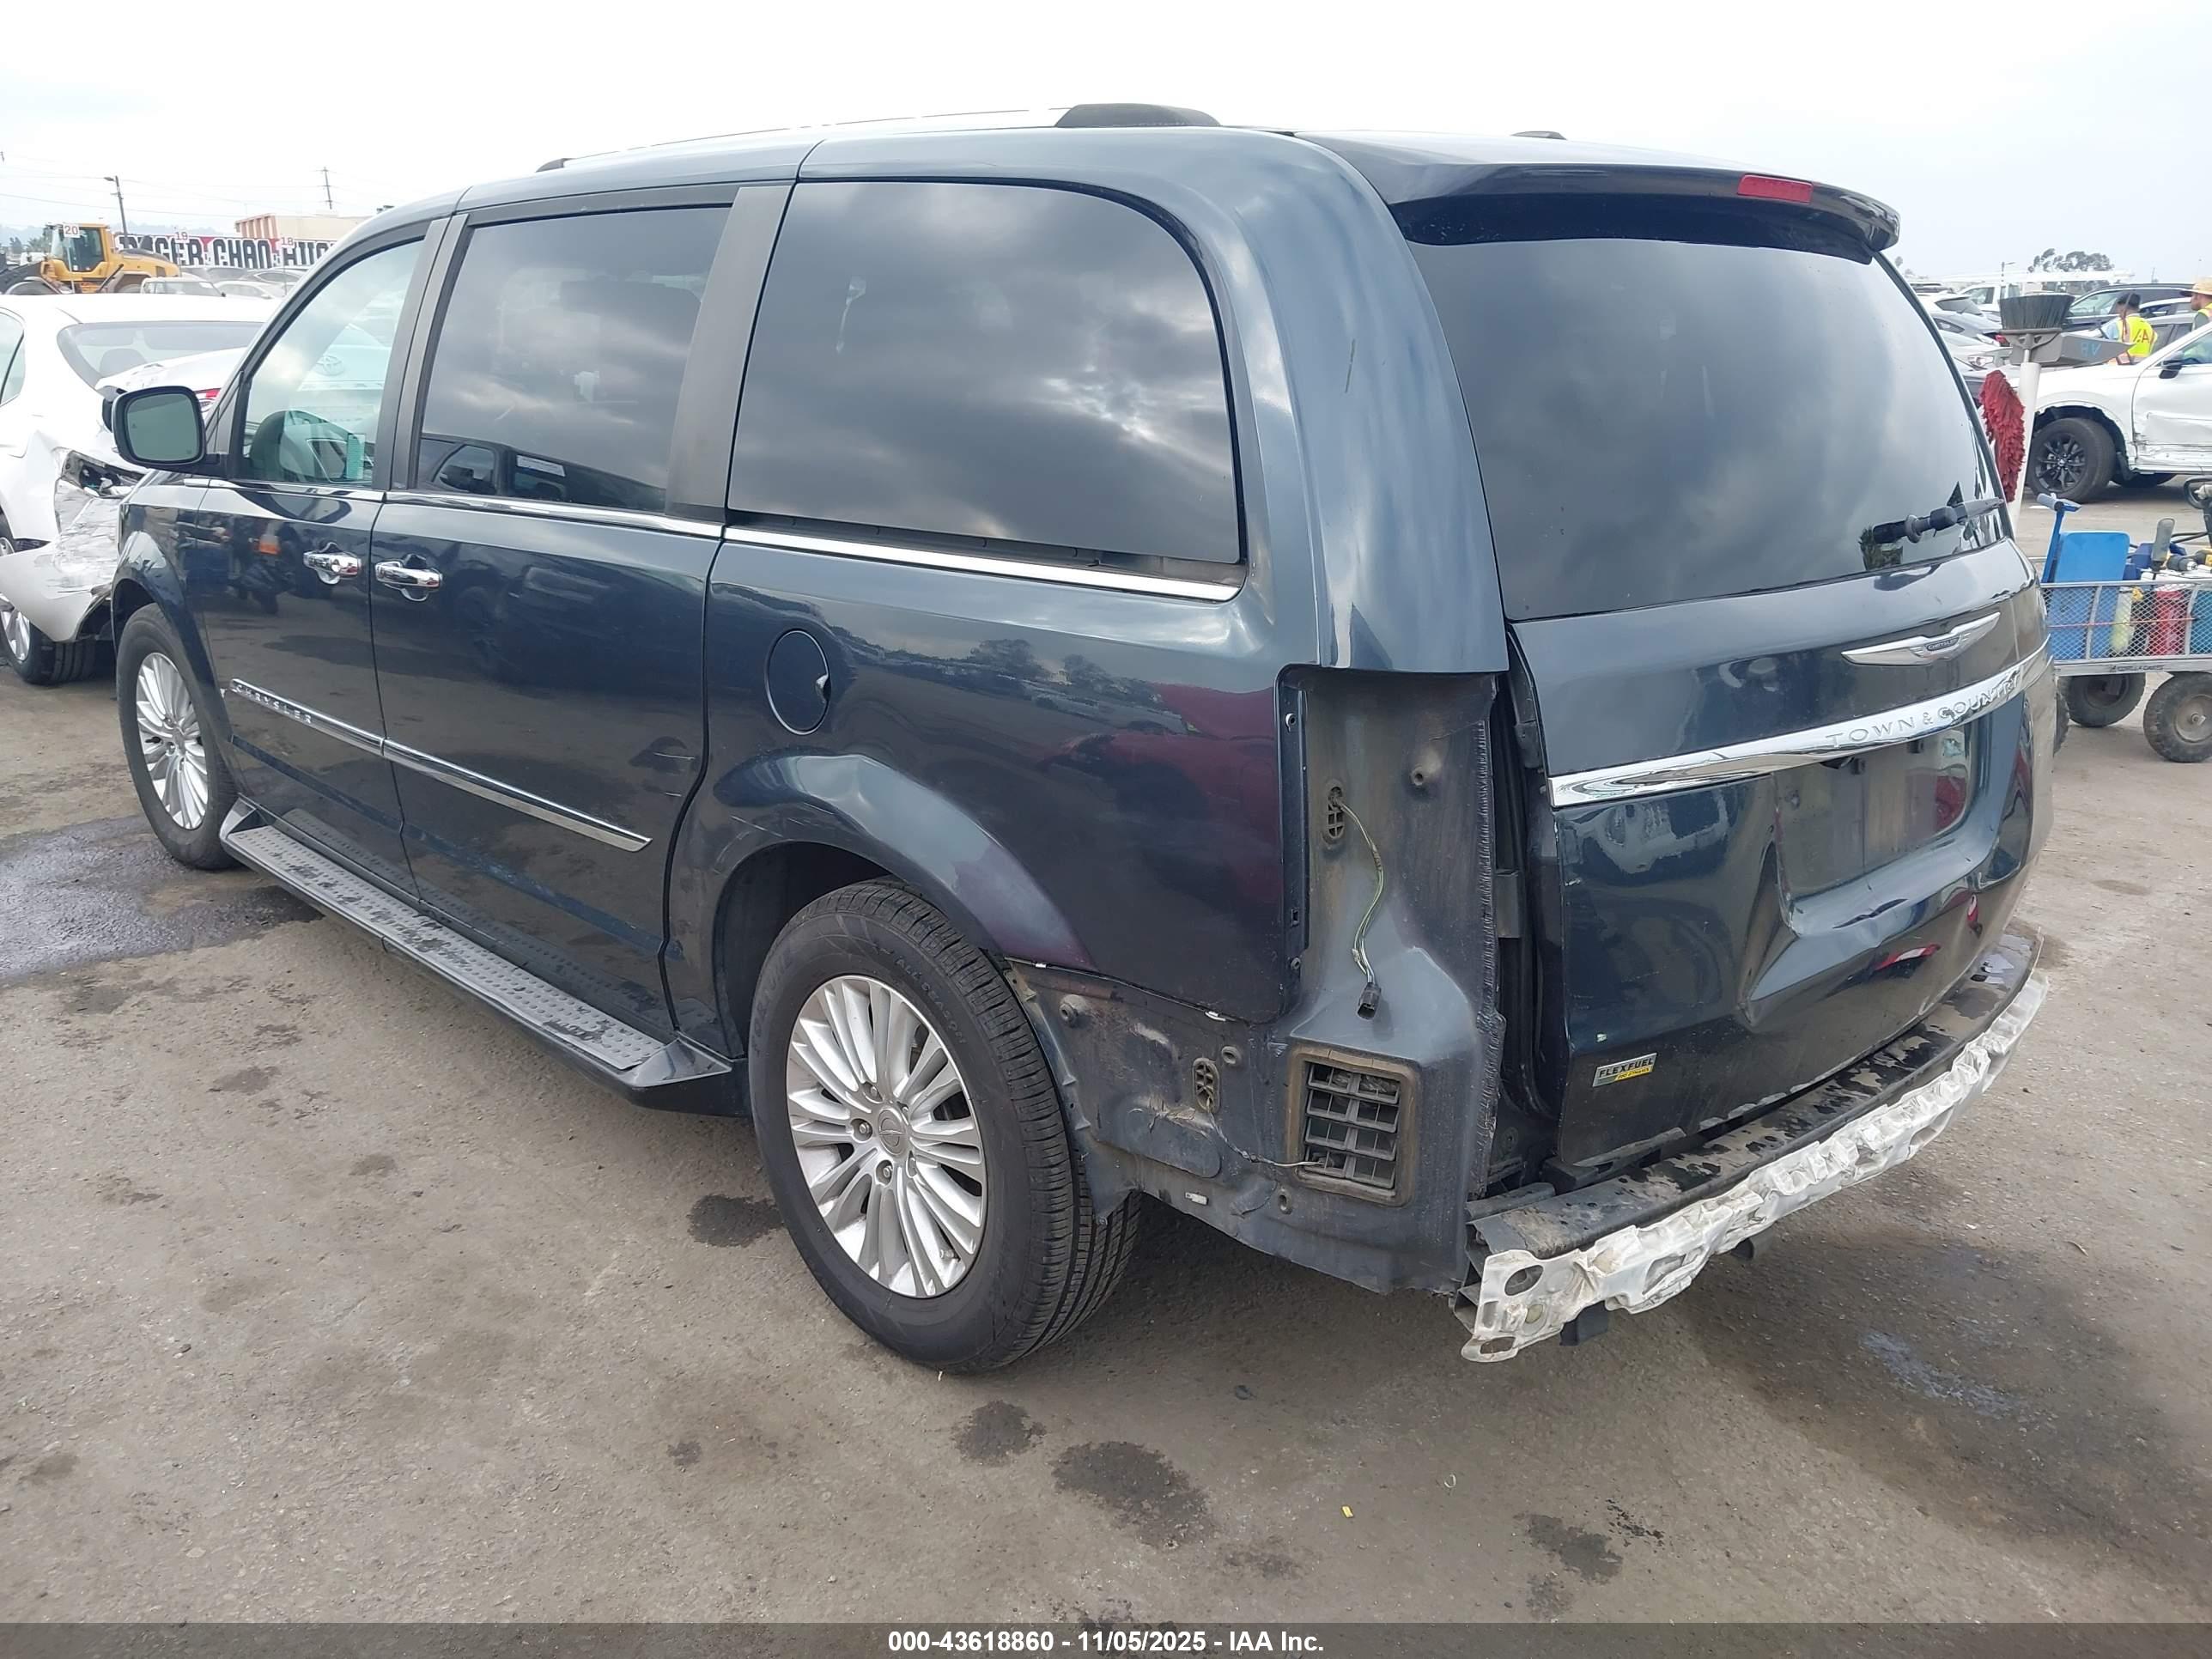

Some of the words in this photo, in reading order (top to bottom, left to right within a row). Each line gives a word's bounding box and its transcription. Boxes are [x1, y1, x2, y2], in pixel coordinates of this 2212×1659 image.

[64, 225, 78, 235] 20
[175, 231, 188, 240] 19
[282, 237, 294, 246] 18
[234, 684, 312, 725] CHRYSLER
[1826, 716, 1916, 747] TOWN
[1923, 711, 1934, 726] &
[1937, 669, 2020, 722] COUNTRY
